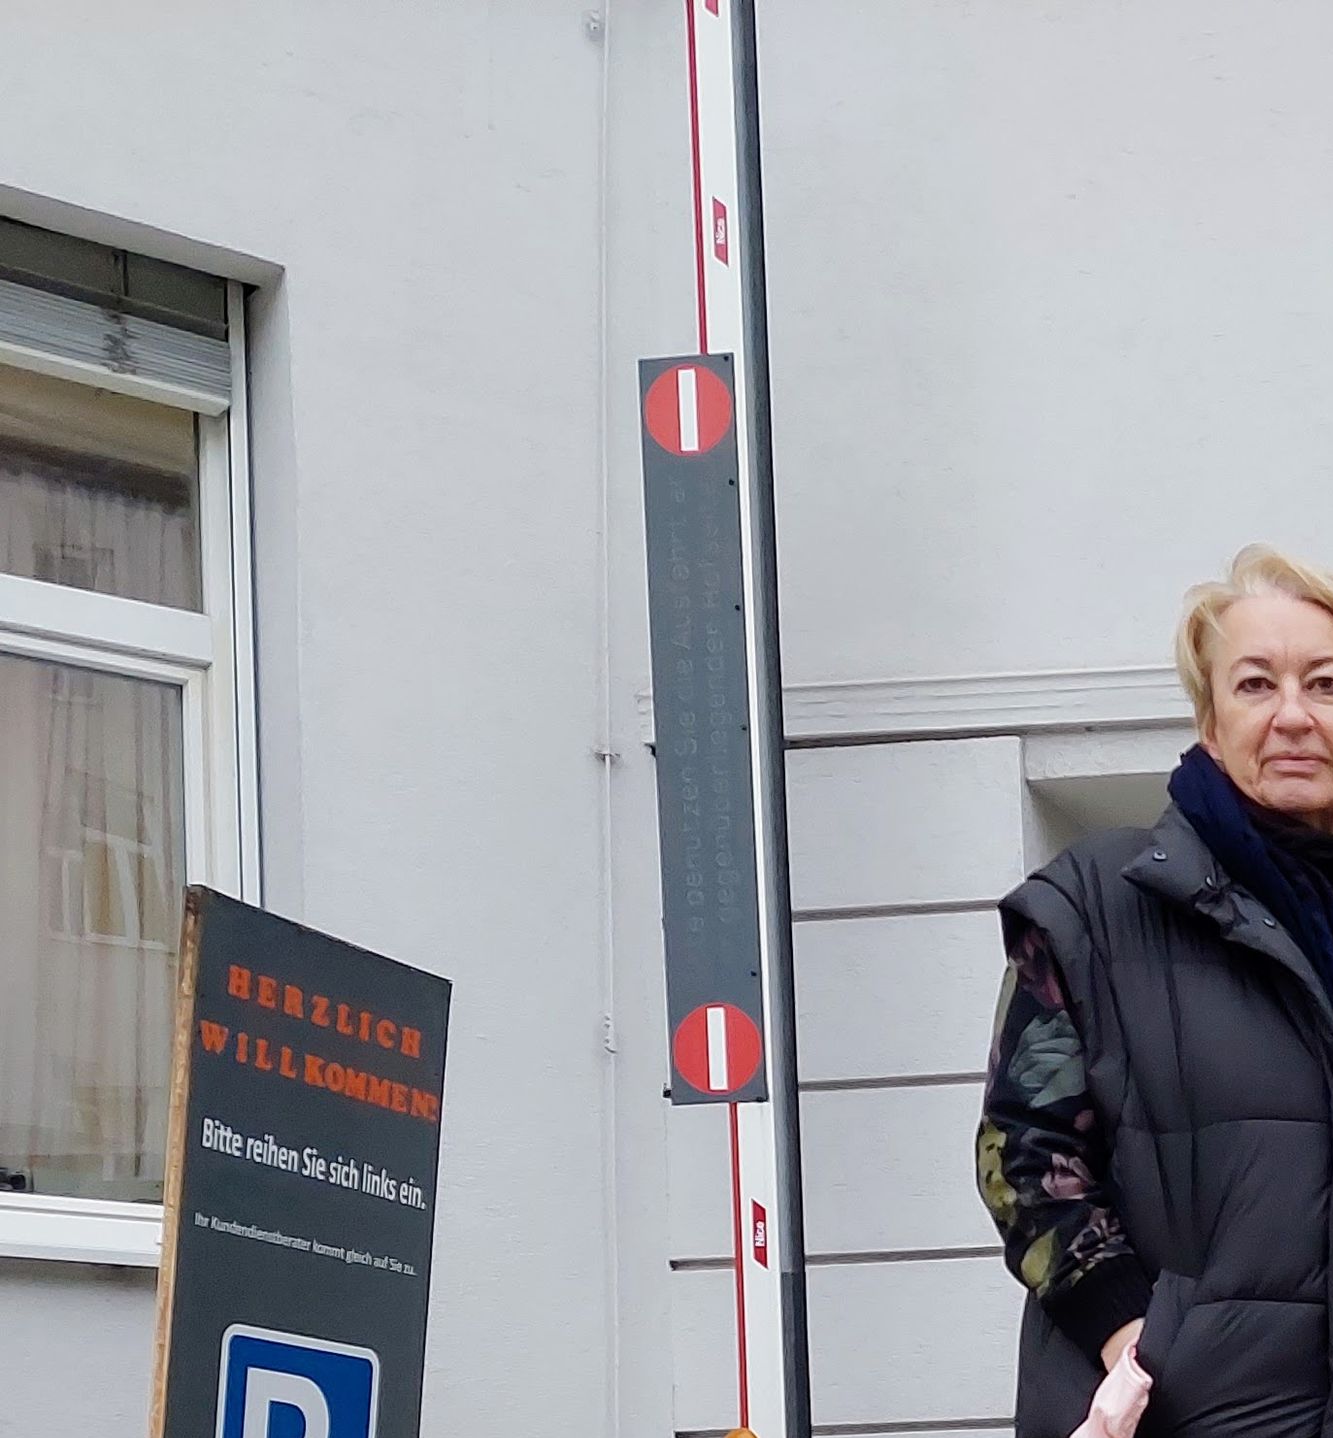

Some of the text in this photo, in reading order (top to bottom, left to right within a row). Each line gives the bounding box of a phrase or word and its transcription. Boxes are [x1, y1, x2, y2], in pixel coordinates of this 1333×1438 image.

[227, 964, 421, 1059] HERZLICH
[202, 1117, 426, 1210] Bitte reihen Sie sich links ein.
